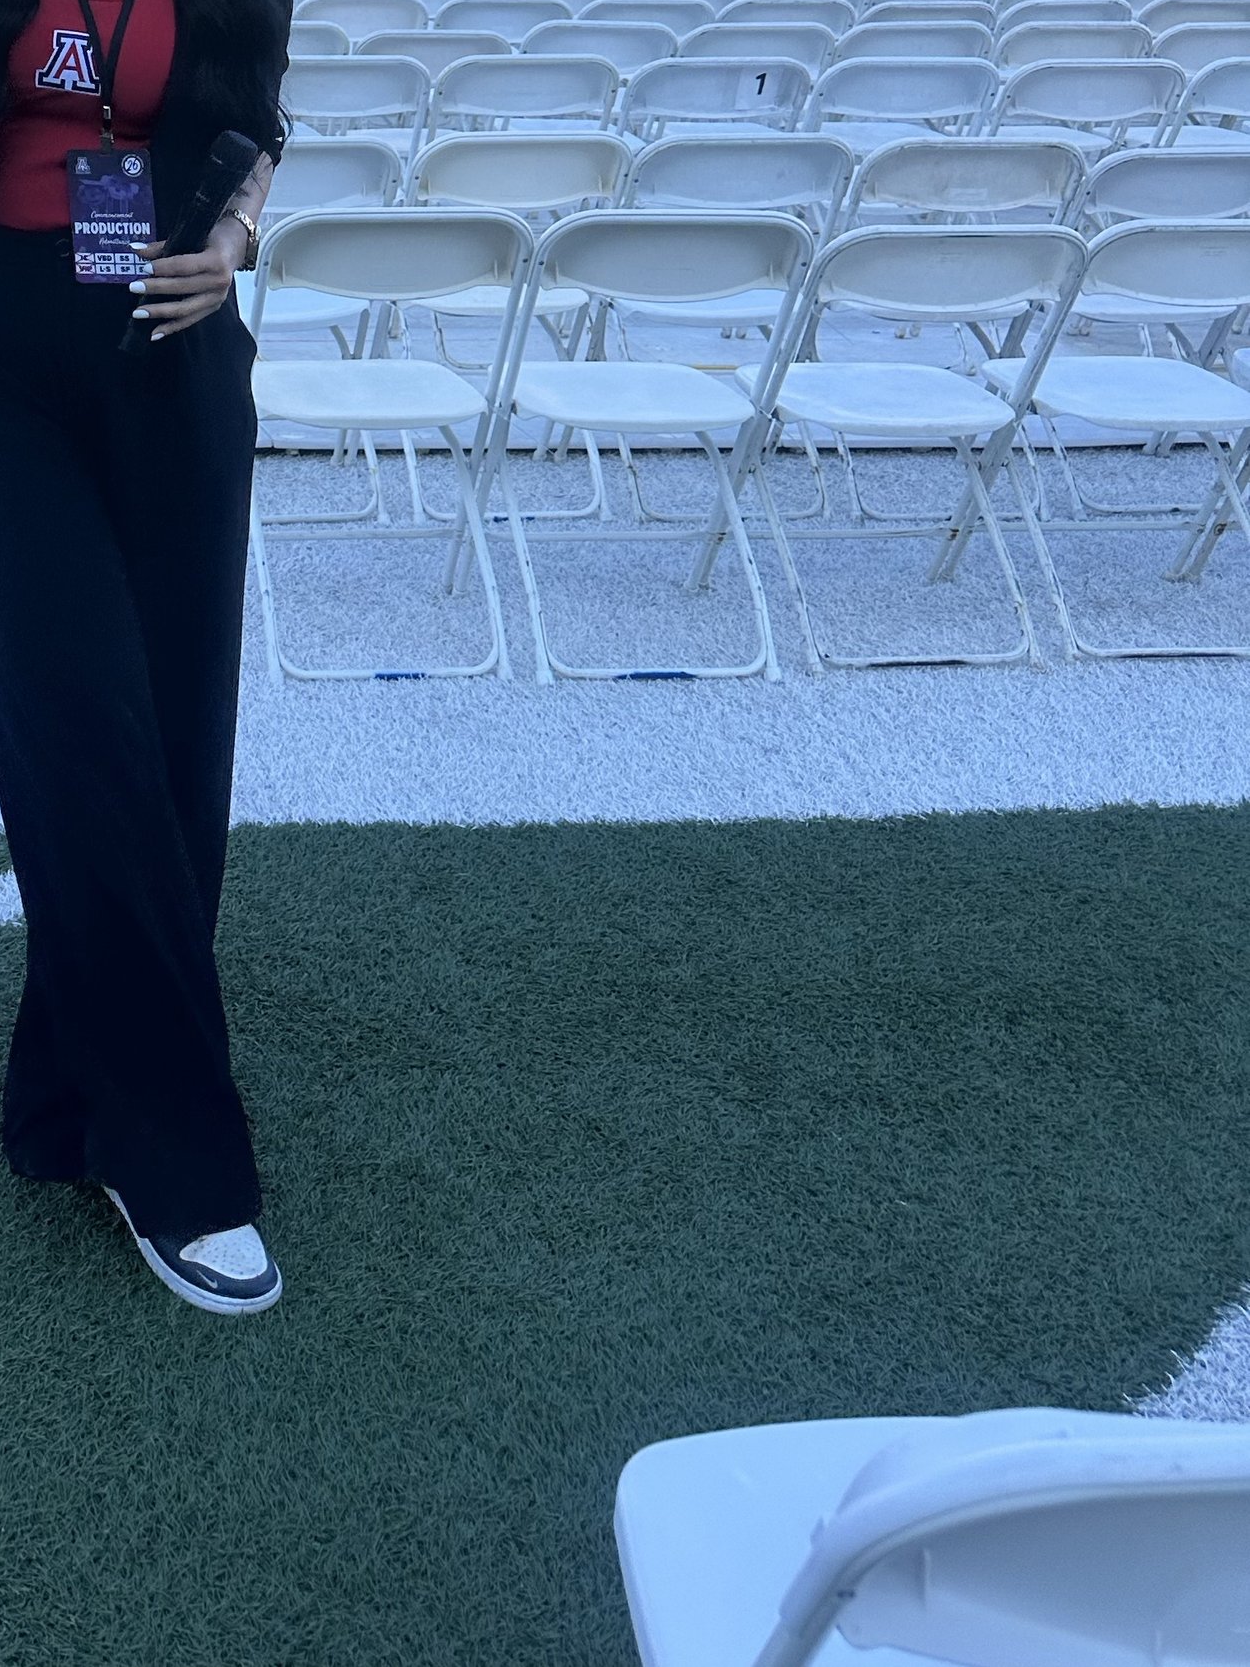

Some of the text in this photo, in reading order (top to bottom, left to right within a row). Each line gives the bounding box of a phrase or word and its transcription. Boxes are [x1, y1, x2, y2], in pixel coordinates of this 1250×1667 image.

[35, 29, 101, 96] A
[755, 72, 767, 95] 1
[74, 222, 151, 234] PRODUCTION
